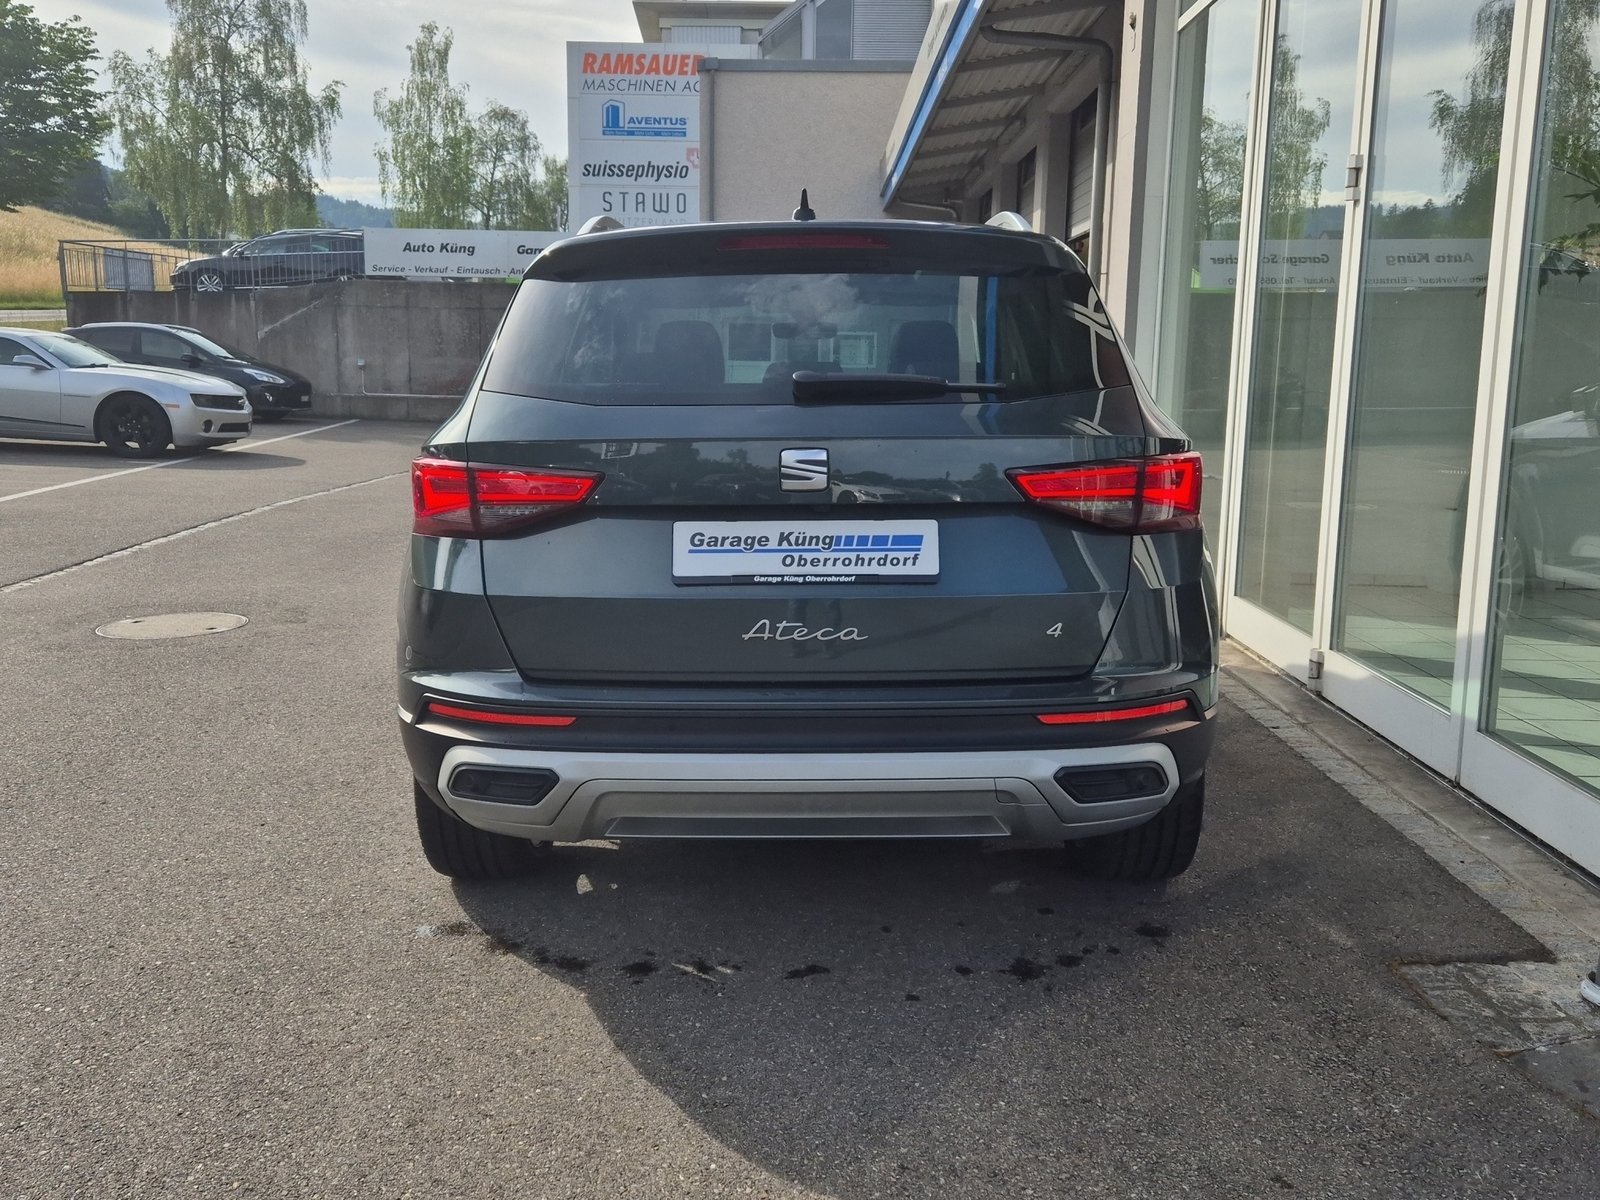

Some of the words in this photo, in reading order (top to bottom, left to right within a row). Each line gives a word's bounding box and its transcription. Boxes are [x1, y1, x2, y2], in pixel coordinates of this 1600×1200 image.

[582, 78, 676, 92] MASCHINEN
[627, 116, 687, 126] AVENTUS
[582, 160, 689, 182] suissephysio
[602, 191, 687, 214] STAWO
[403, 242, 435, 253] Auto
[439, 242, 476, 256] Küng
[517, 244, 545, 255] Gar
[372, 264, 406, 273] Service
[414, 265, 448, 274] Verkauf
[456, 266, 501, 275] Eintausch
[689, 532, 770, 552] Garage
[777, 531, 835, 552] Küng
[781, 553, 920, 568] Oberrohrdorf
[753, 575, 782, 583] Garage
[783, 575, 804, 583] Küng
[741, 618, 869, 641] Ateca
[1046, 622, 1063, 638] 4
